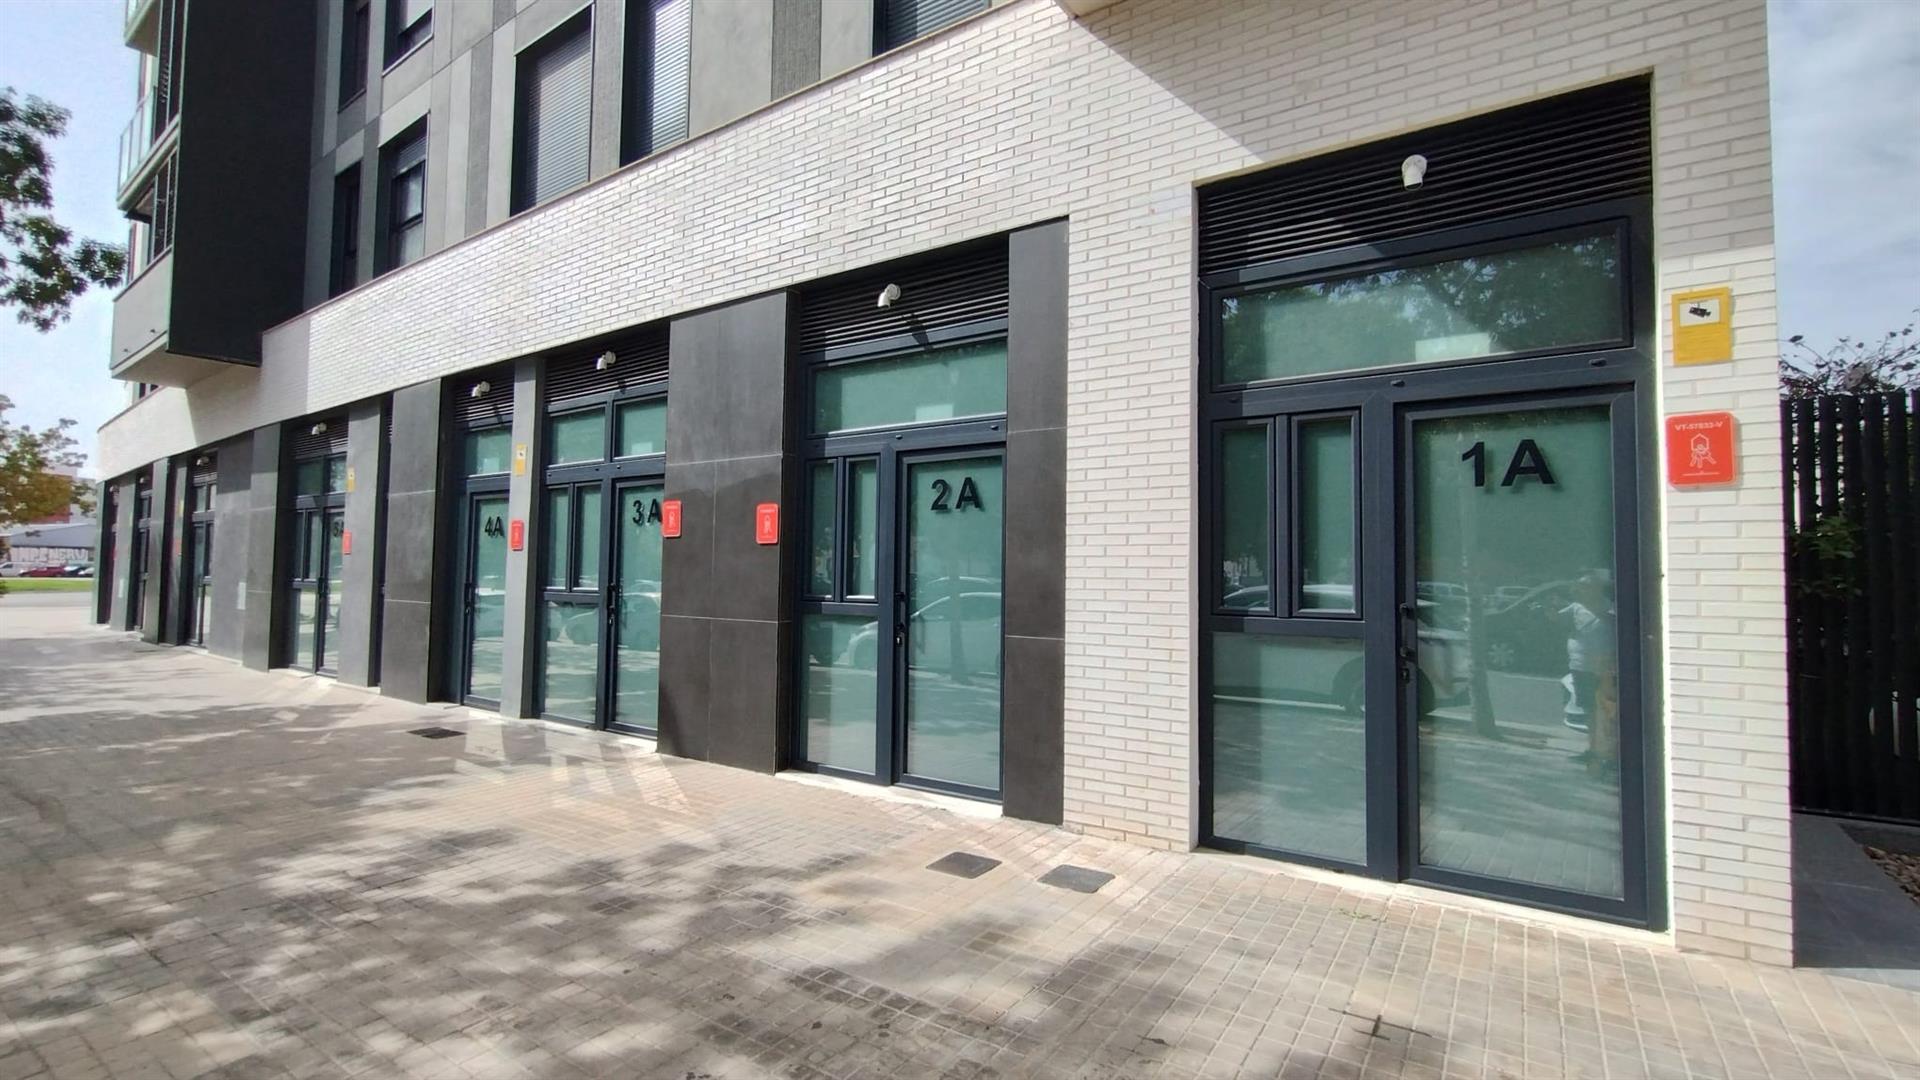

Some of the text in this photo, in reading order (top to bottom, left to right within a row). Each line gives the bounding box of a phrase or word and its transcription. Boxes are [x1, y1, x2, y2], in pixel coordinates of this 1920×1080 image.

[1461, 439, 1556, 487] 1A
[930, 476, 982, 511] 2A
[484, 516, 504, 536] 4A
[632, 498, 663, 524] 3A
